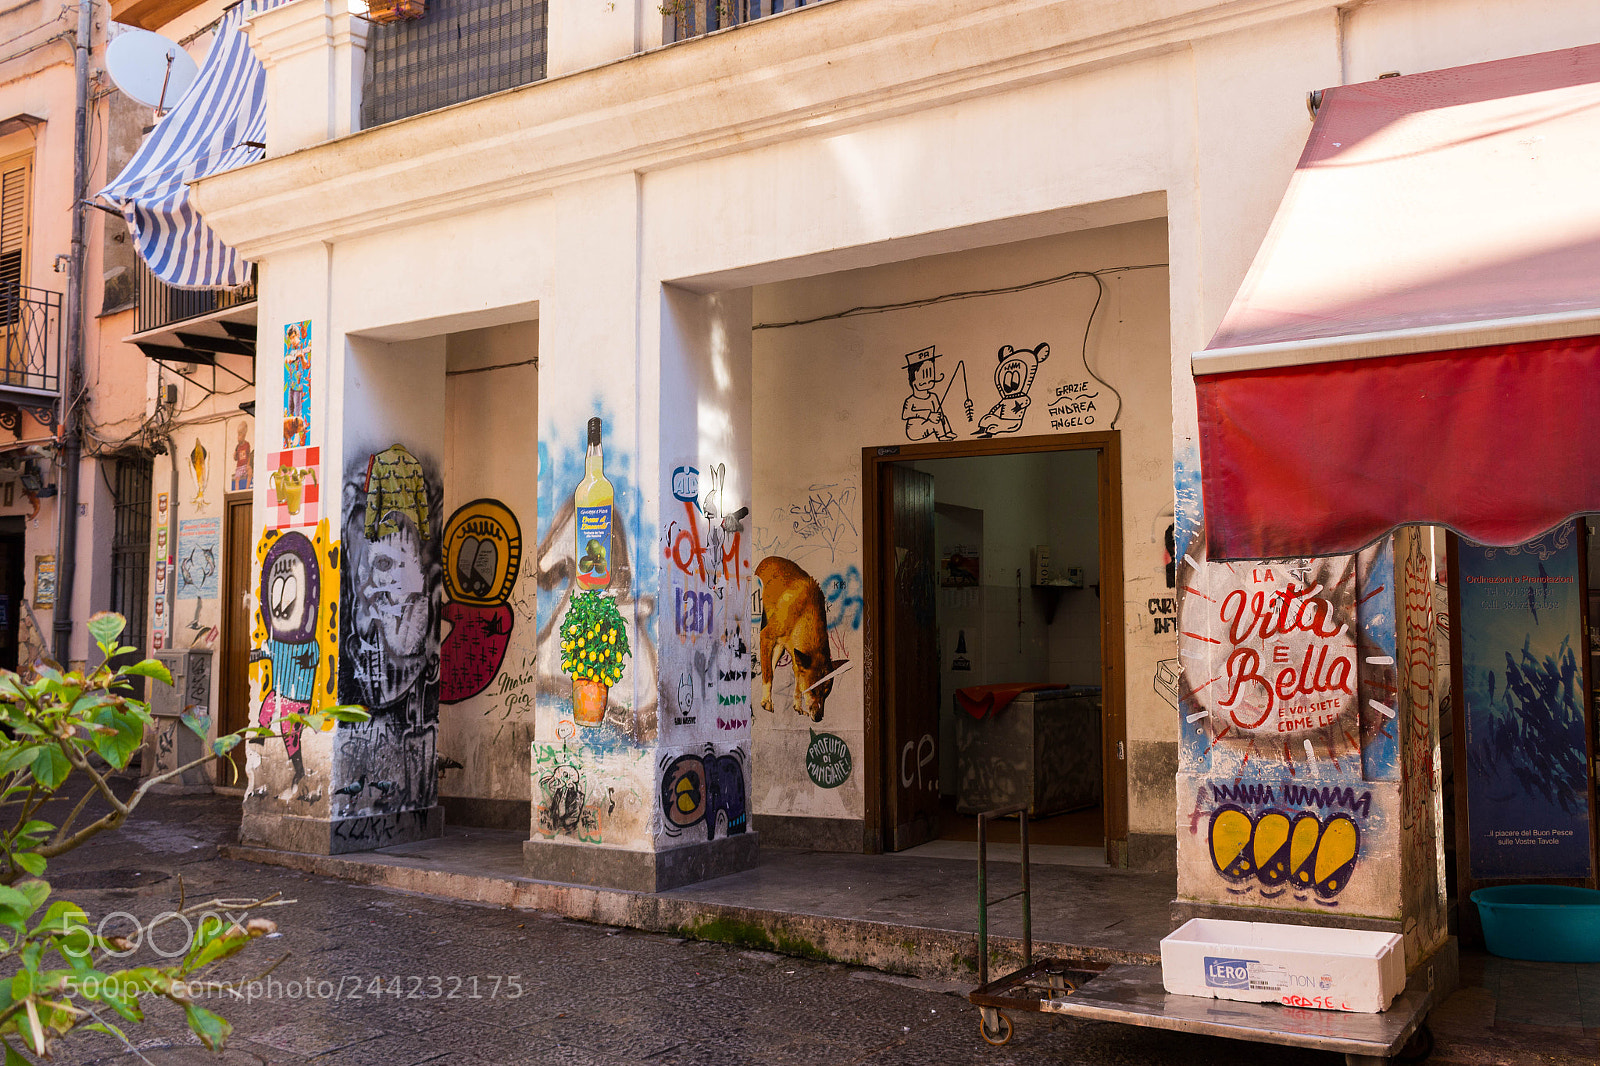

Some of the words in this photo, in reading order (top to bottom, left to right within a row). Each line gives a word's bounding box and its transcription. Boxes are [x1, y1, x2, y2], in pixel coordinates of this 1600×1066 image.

[1048, 400, 1097, 417] ANDREA
[1050, 415, 1095, 430] ANGELO
[1253, 568, 1275, 583] LA
[1465, 575, 1513, 584] Ordinazioni
[1521, 575, 1574, 584] Prenotazioni
[1219, 580, 1349, 646] Vita
[497, 670, 535, 696] Maria
[1218, 644, 1354, 729] Bella
[1278, 707, 1286, 718] E
[1289, 705, 1307, 715] VOI
[1309, 698, 1341, 713] SIETE
[1277, 716, 1314, 732] COME
[808, 737, 847, 759] PROFUMO
[1495, 829, 1519, 839] piacere
[1520, 829, 1531, 837] del
[1497, 838, 1513, 846] sulle
[1514, 837, 1536, 845] Vostre
[1537, 837, 1560, 845] Tavole
